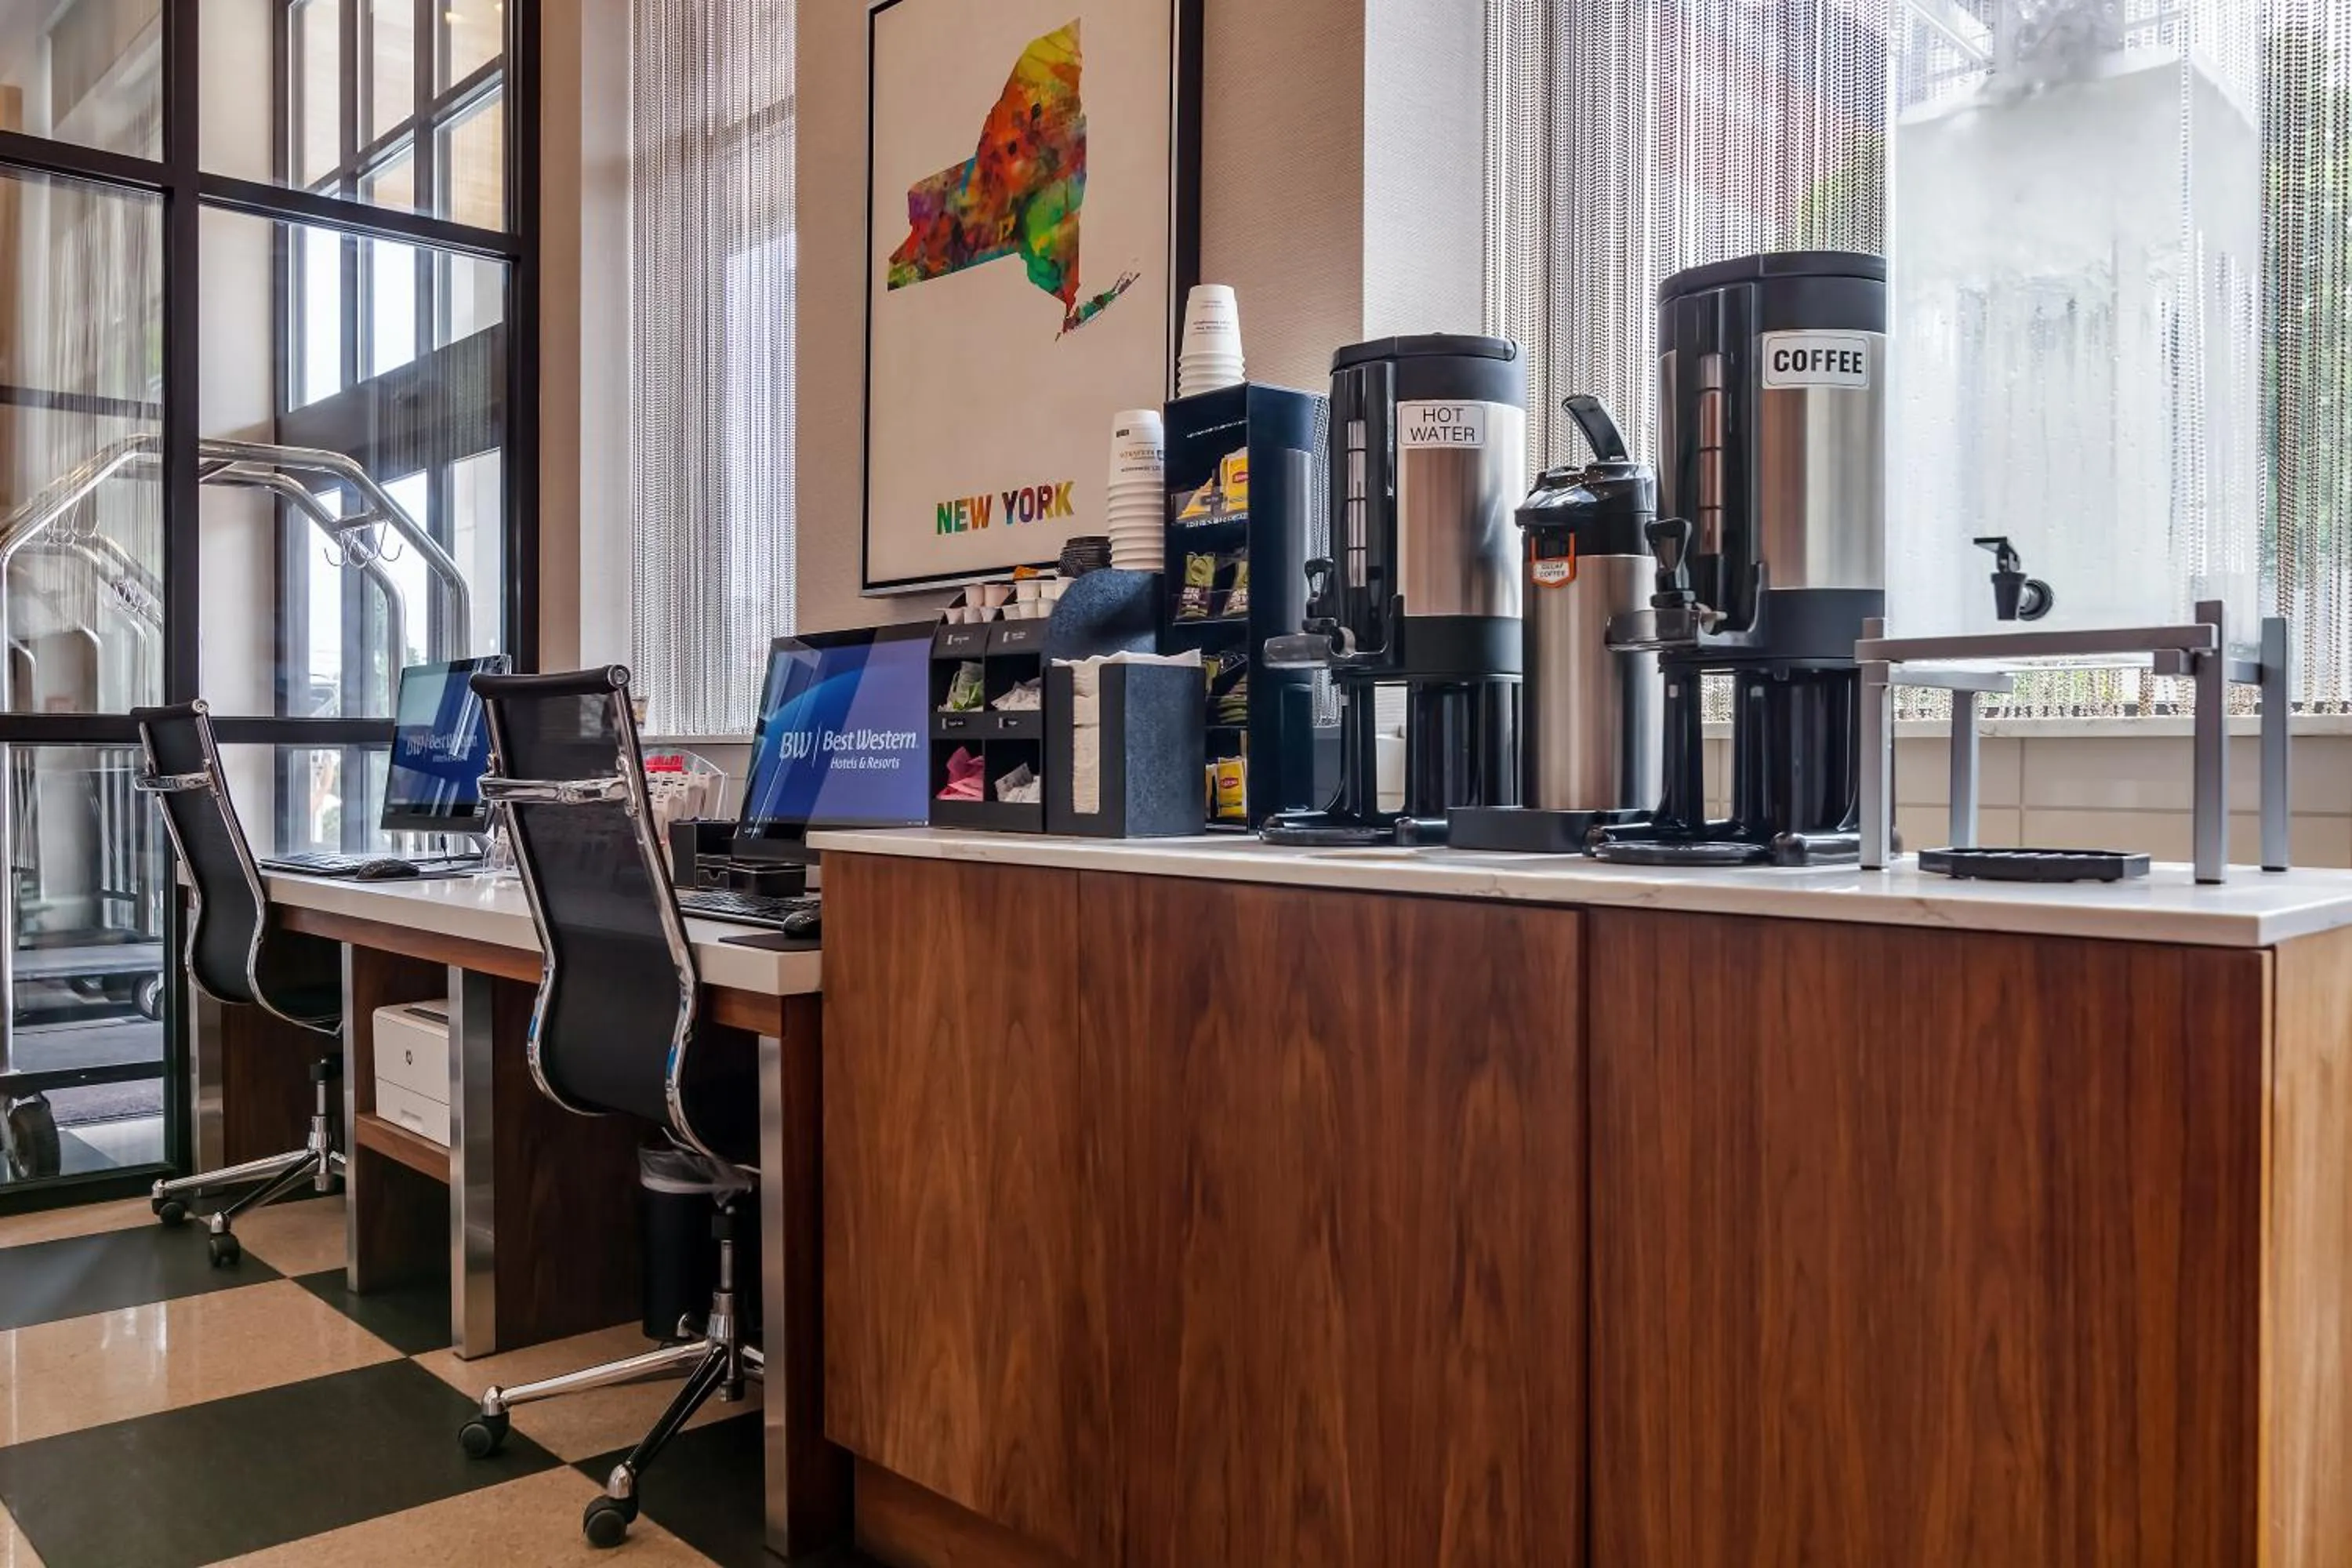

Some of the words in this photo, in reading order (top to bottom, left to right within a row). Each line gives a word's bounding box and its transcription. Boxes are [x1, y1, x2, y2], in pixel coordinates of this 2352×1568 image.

[1773, 349, 1863, 374] COFFEE
[1423, 407, 1465, 423] HOT
[1410, 426, 1475, 441] WATER
[937, 494, 993, 535] NEW
[1002, 481, 1074, 524] YORK
[779, 731, 813, 760] BW
[823, 730, 855, 752] Best
[855, 728, 917, 750] Western
[829, 757, 857, 769] Hotels
[858, 757, 866, 769] &
[866, 757, 900, 769] Resorts
